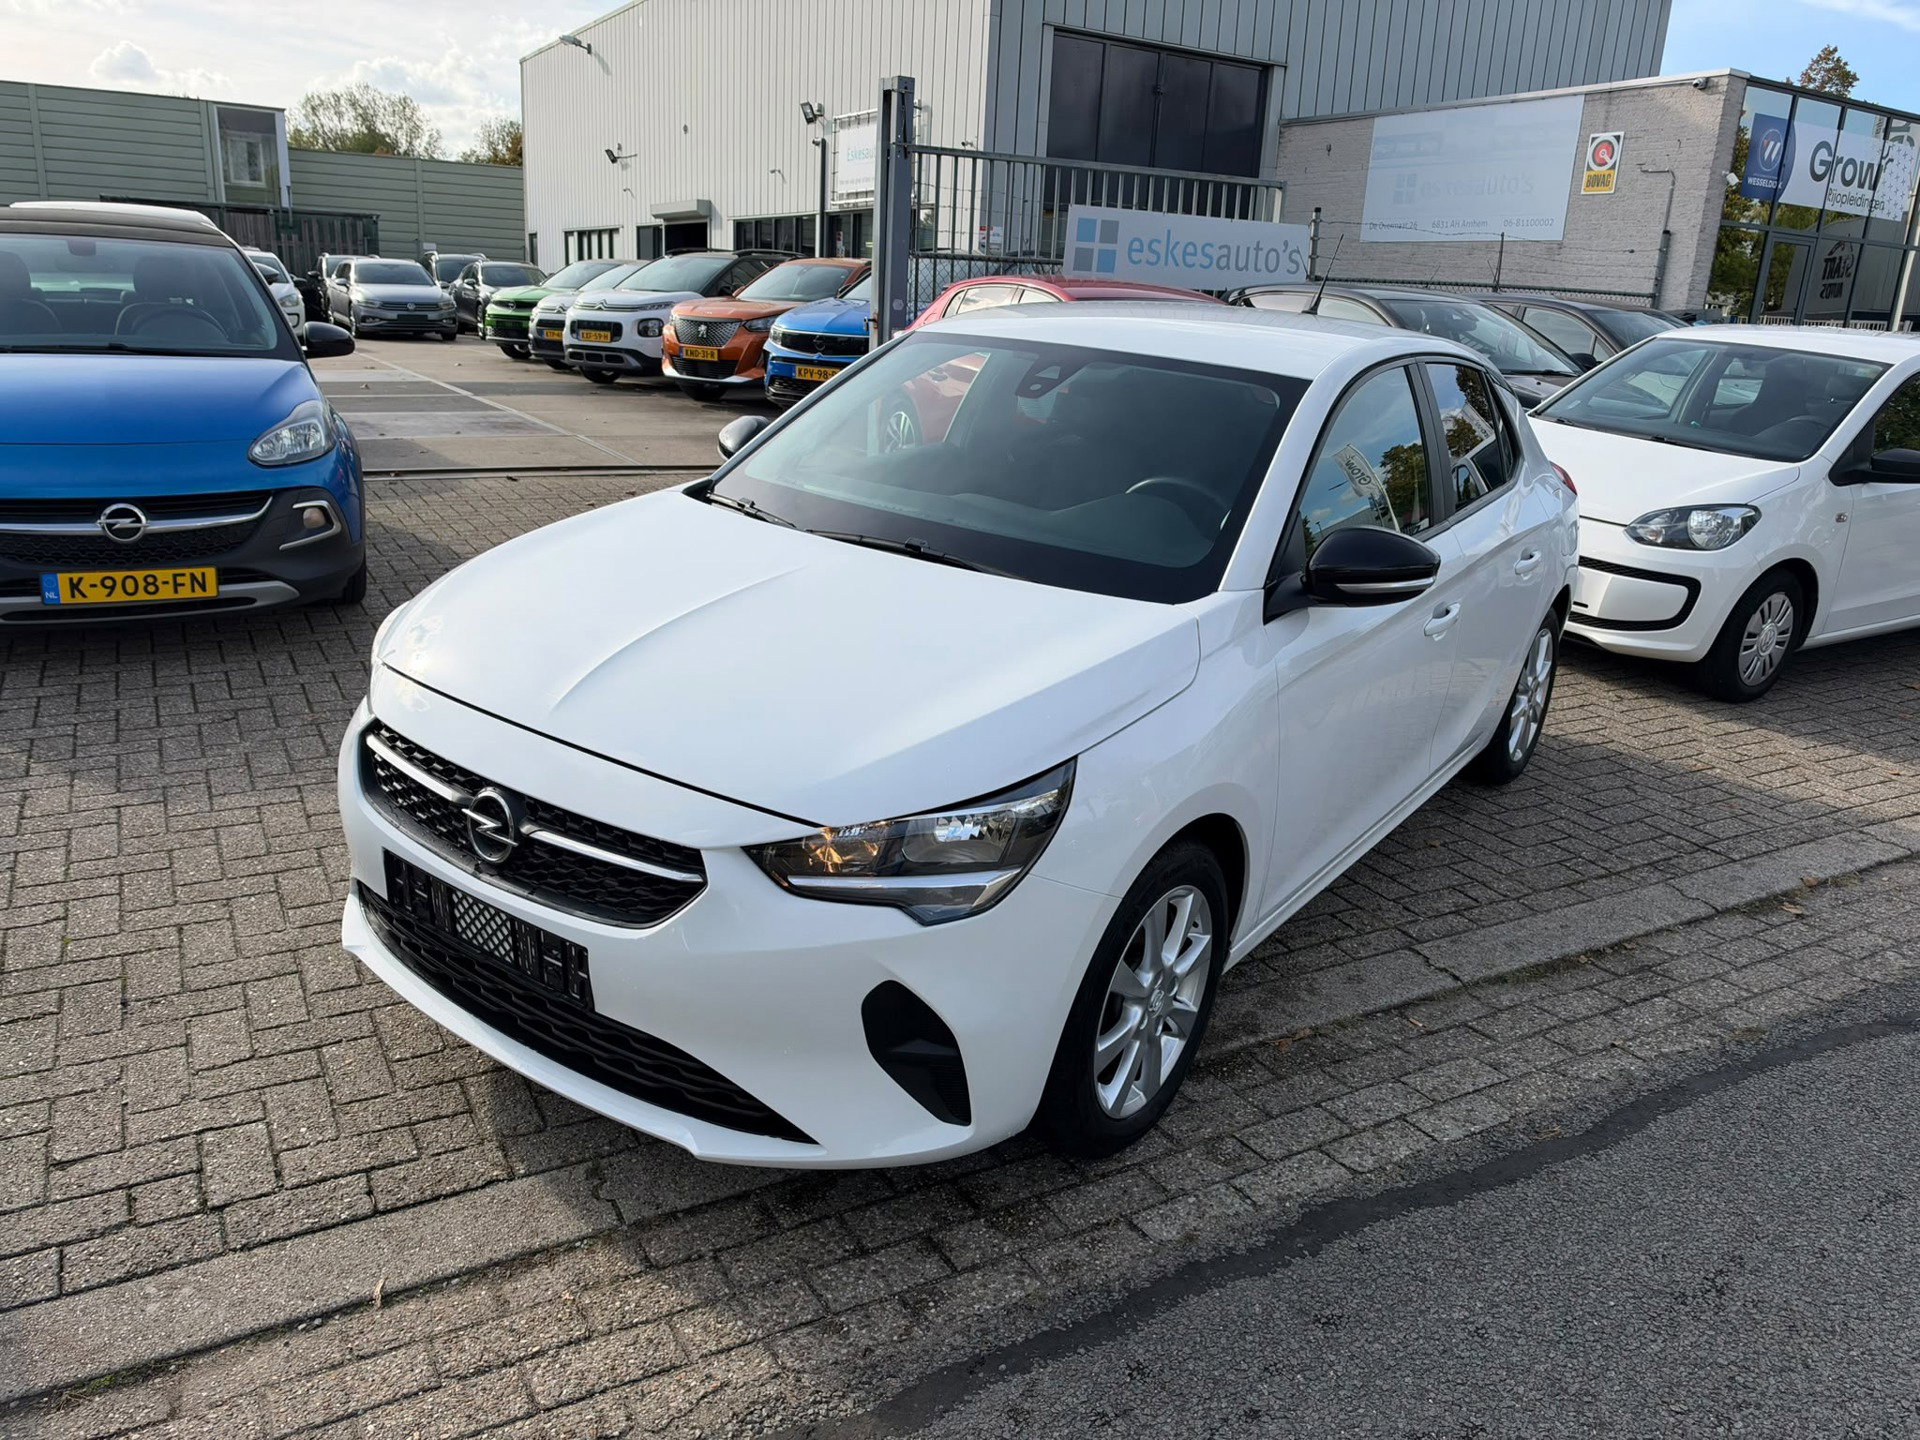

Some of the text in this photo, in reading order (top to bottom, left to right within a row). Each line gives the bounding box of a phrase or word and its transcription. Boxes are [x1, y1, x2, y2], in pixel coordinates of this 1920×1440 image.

[1809, 140, 1881, 191] Grow
[1585, 173, 1612, 188] BOVAG
[1431, 219, 1449, 229] 6831
[1460, 218, 1488, 228] Arnhem
[1502, 217, 1555, 228] 06-81100002
[1127, 228, 1301, 276] eskesauto's
[684, 349, 715, 360] KND-31-R
[44, 571, 208, 600] NL K-908-FN
